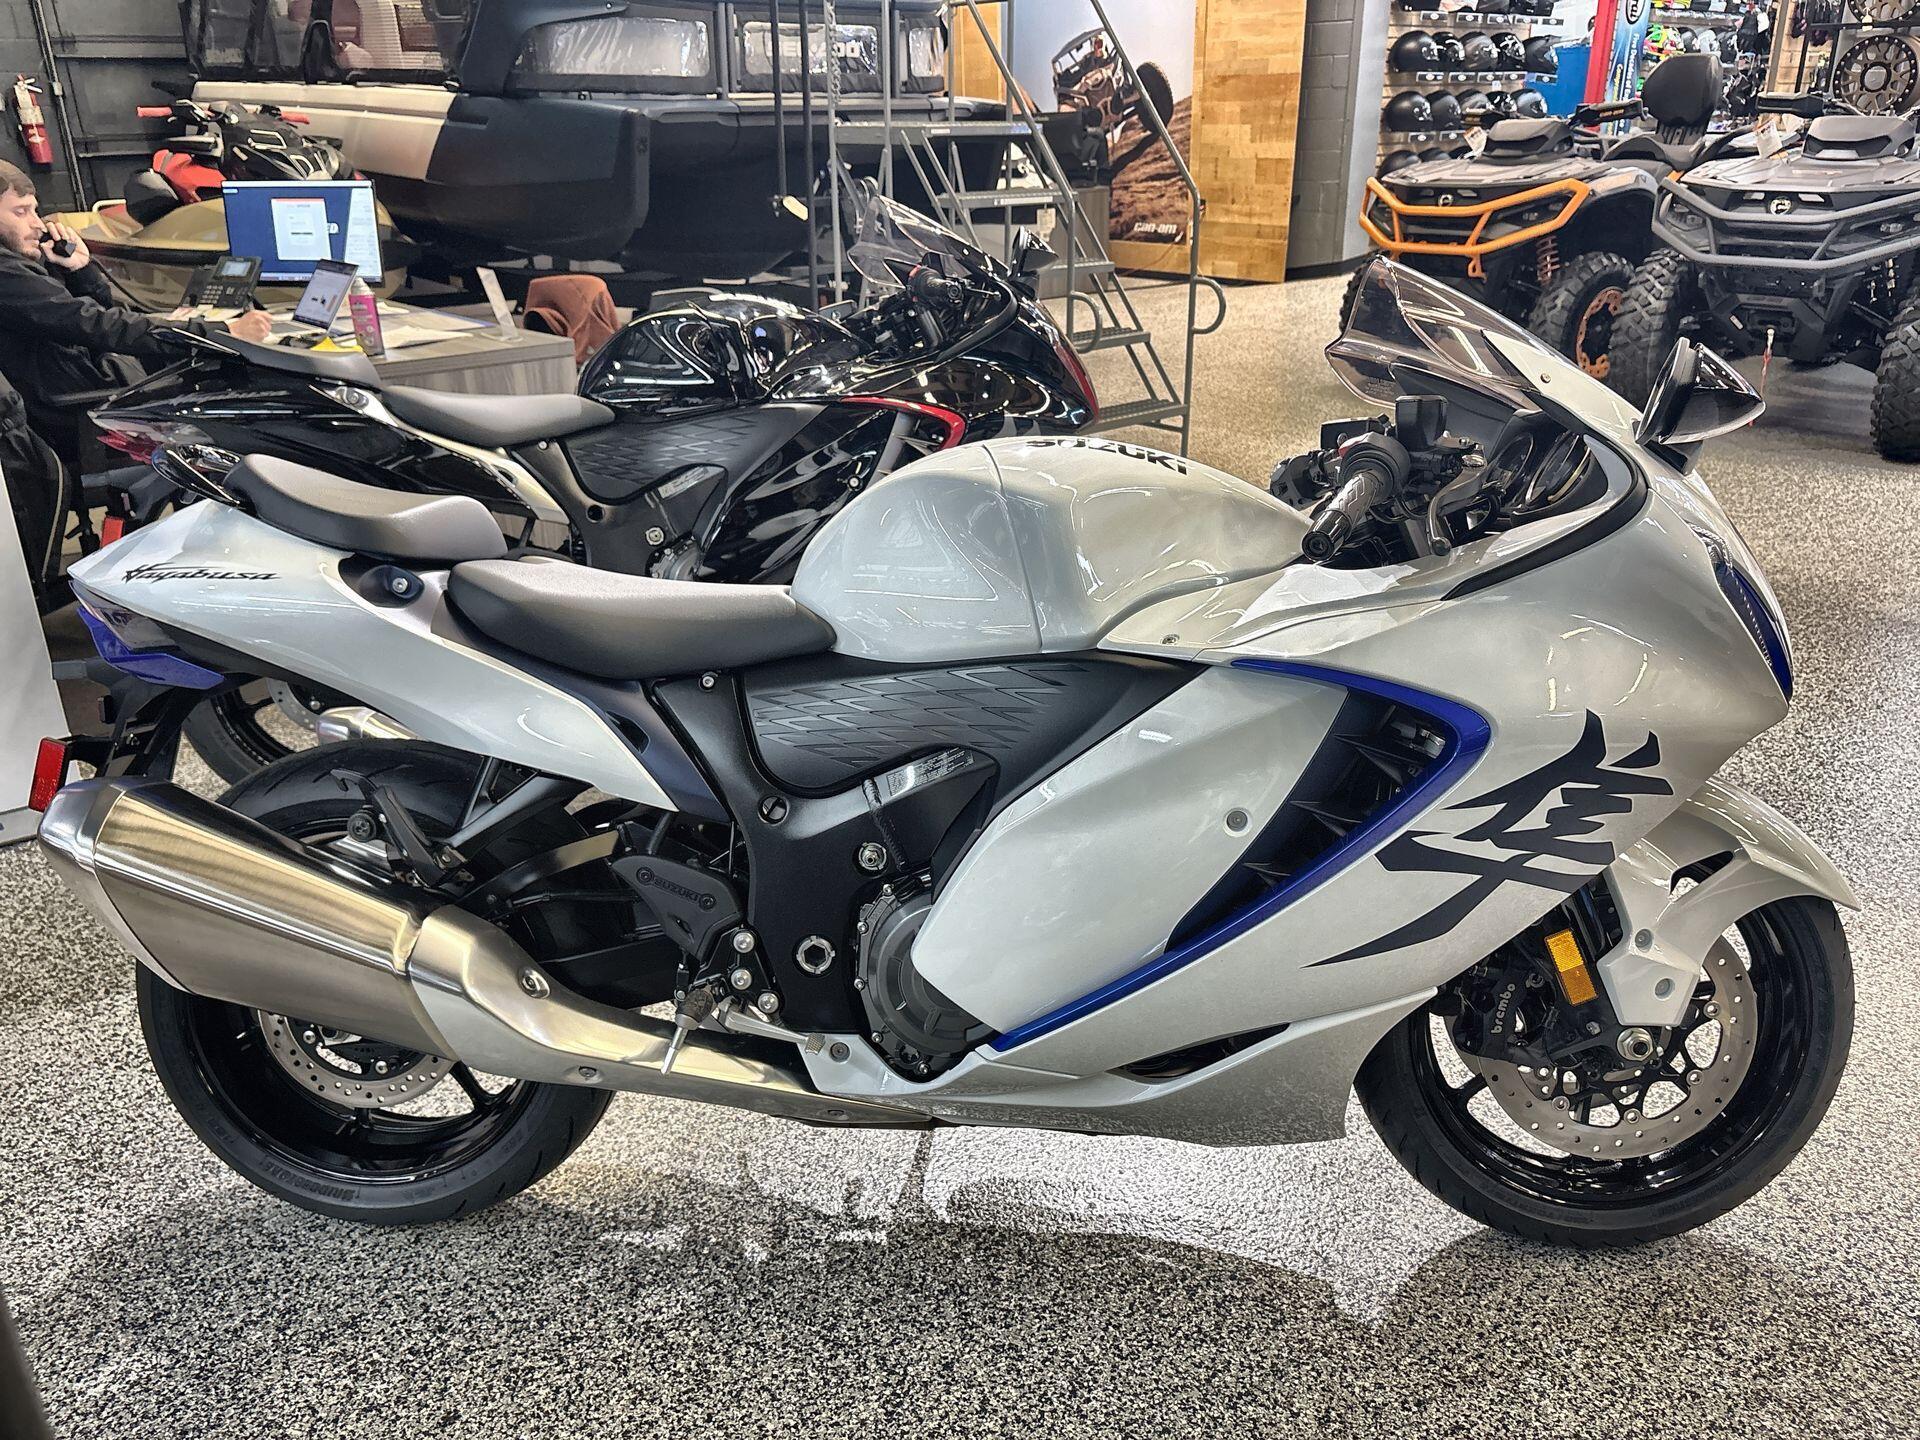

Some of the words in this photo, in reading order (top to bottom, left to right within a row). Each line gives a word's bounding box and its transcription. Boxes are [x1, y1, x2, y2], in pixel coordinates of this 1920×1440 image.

[1026, 438, 1187, 475] SUZUKI
[122, 562, 282, 584] Hayabusa
[654, 877, 699, 902] SUZUKI
[1490, 983, 1516, 1034] brembo
